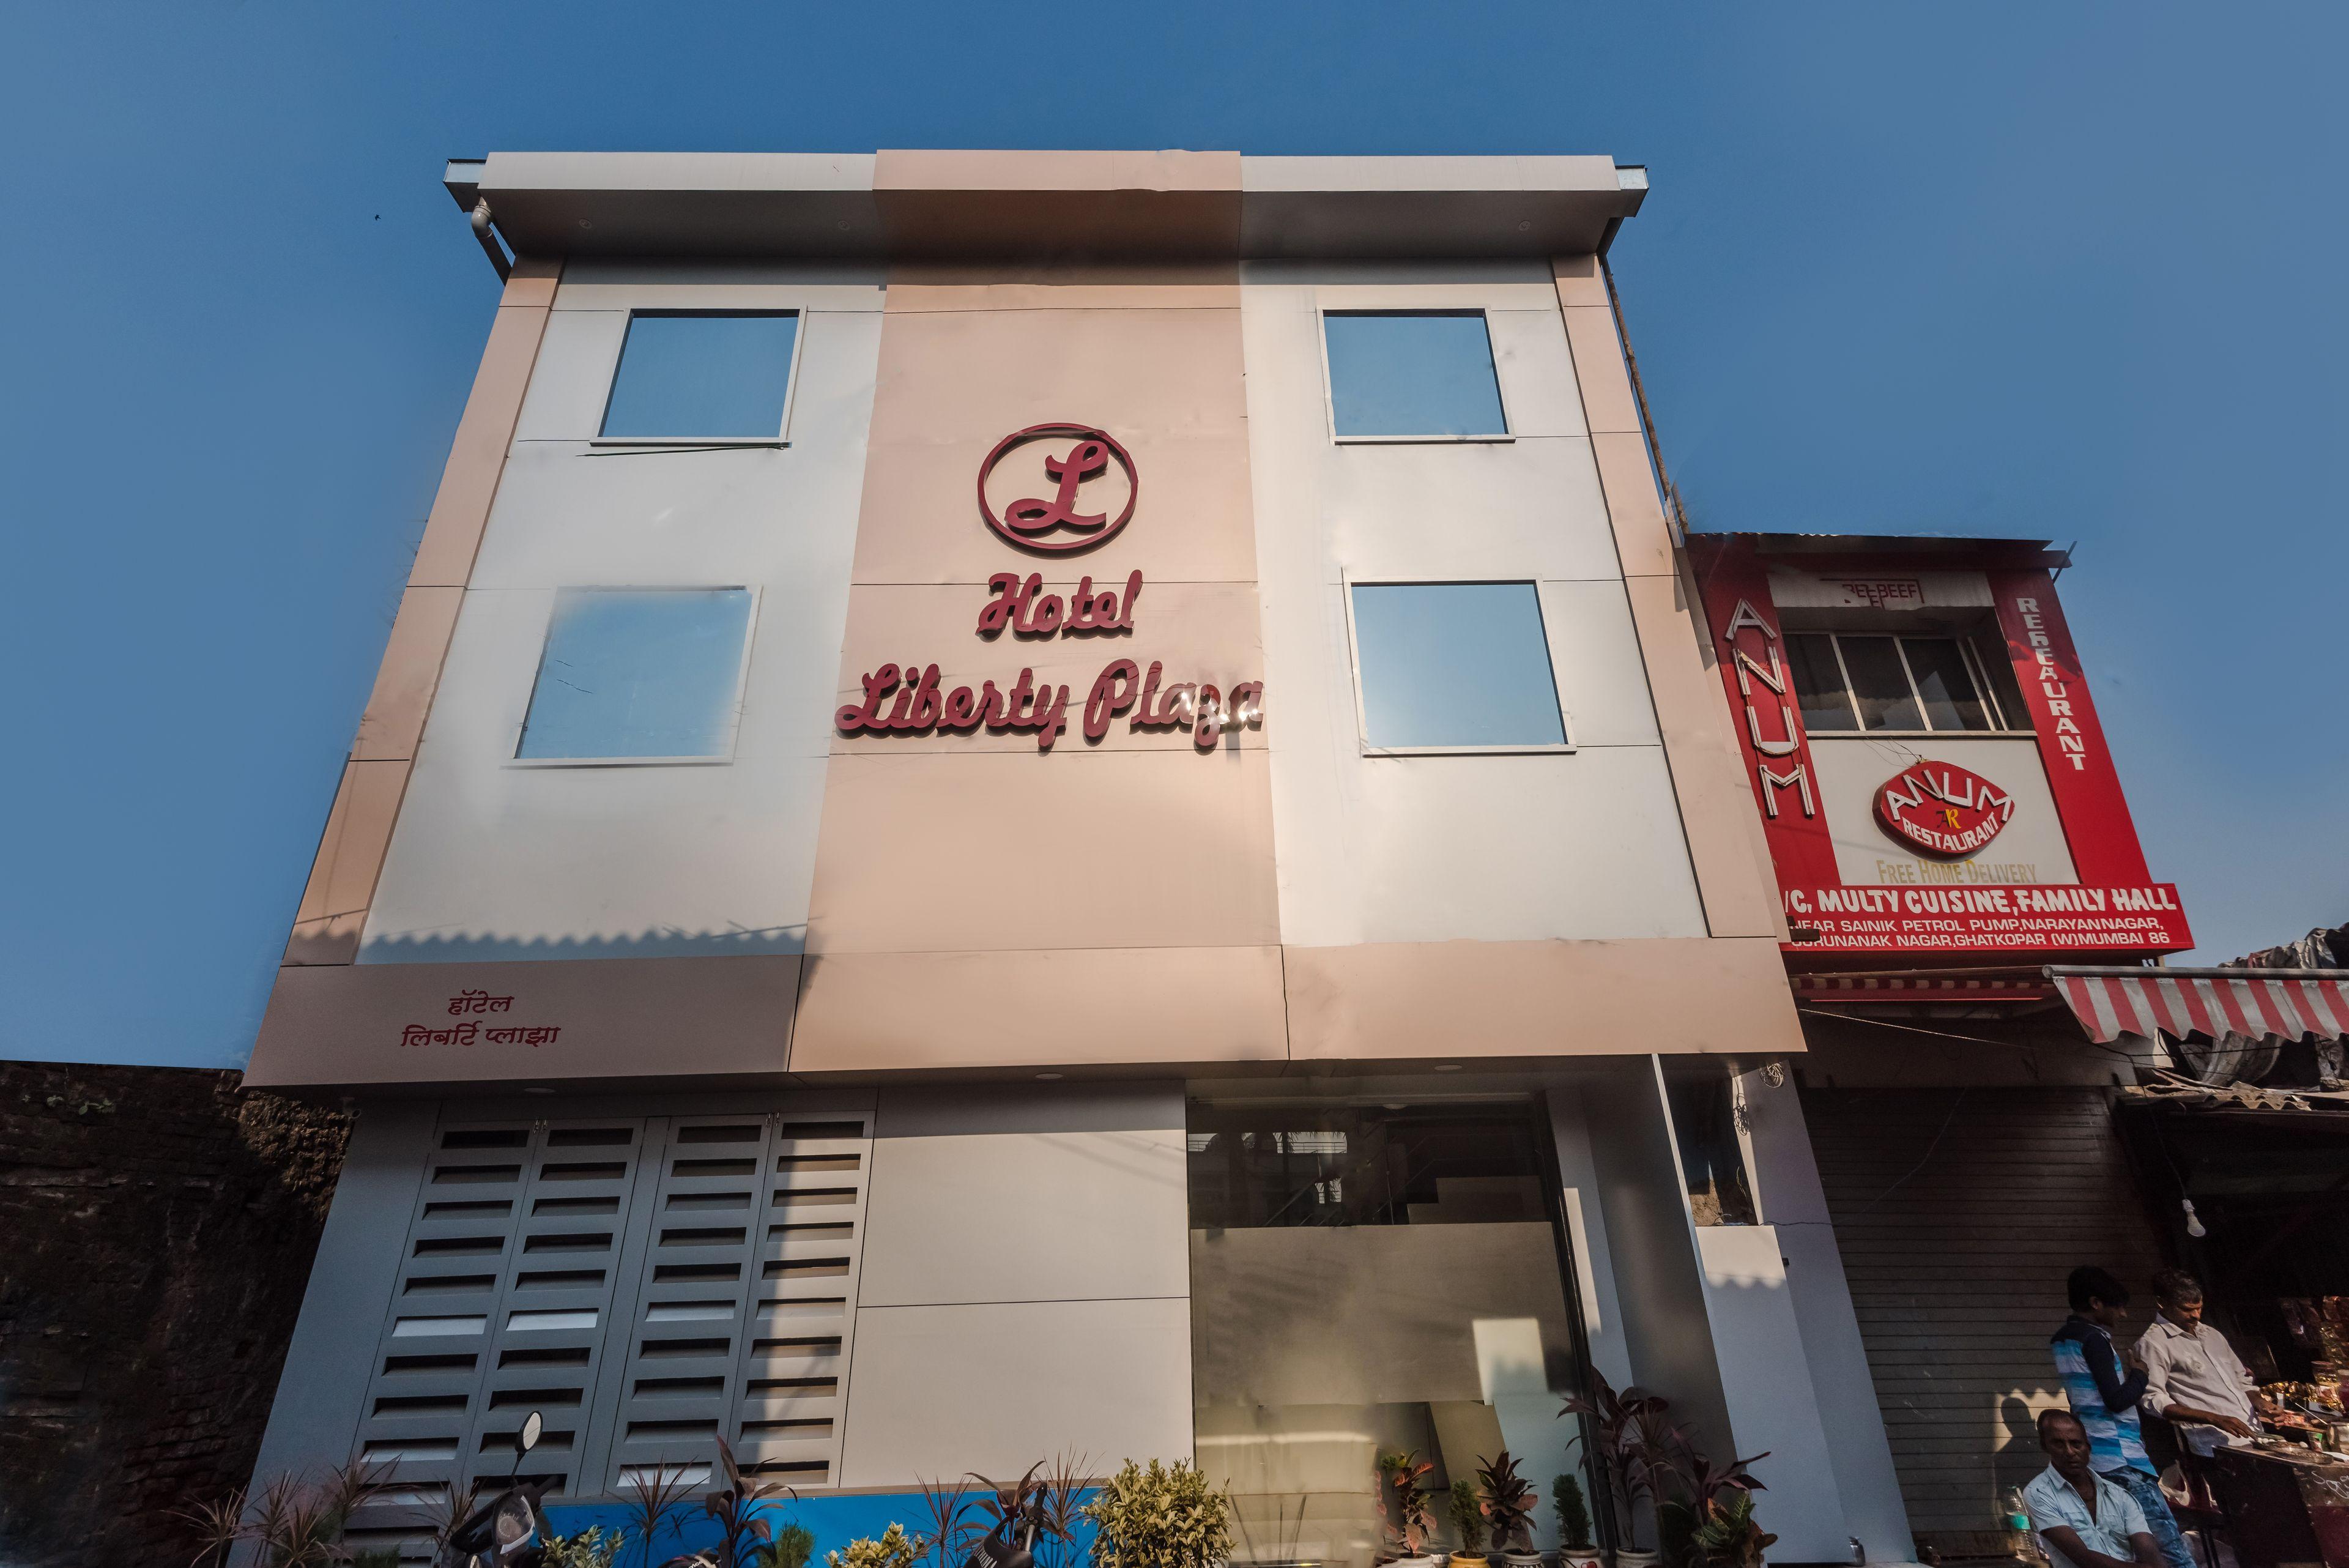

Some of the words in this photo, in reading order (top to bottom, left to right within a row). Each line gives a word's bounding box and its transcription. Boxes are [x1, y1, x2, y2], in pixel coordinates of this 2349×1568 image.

[976, 570, 1143, 642] Hotel
[835, 663, 1069, 754] Liberty
[1083, 658, 1264, 753] Plaza
[1725, 598, 1816, 817] ANUM
[1886, 769, 2013, 823] ANUM
[1902, 811, 1999, 851] RESTAURANT
[1817, 890, 1899, 912] MULTY
[2111, 888, 2177, 911] HALL
[1841, 920, 1898, 932] SAINIK
[1902, 919, 1965, 932] PETROL
[2148, 932, 2170, 944] 86
[448, 989, 514, 1015] हॉटेल
[401, 1020, 483, 1047] लिबर्टि
[486, 1027, 561, 1047] प्लाझा
